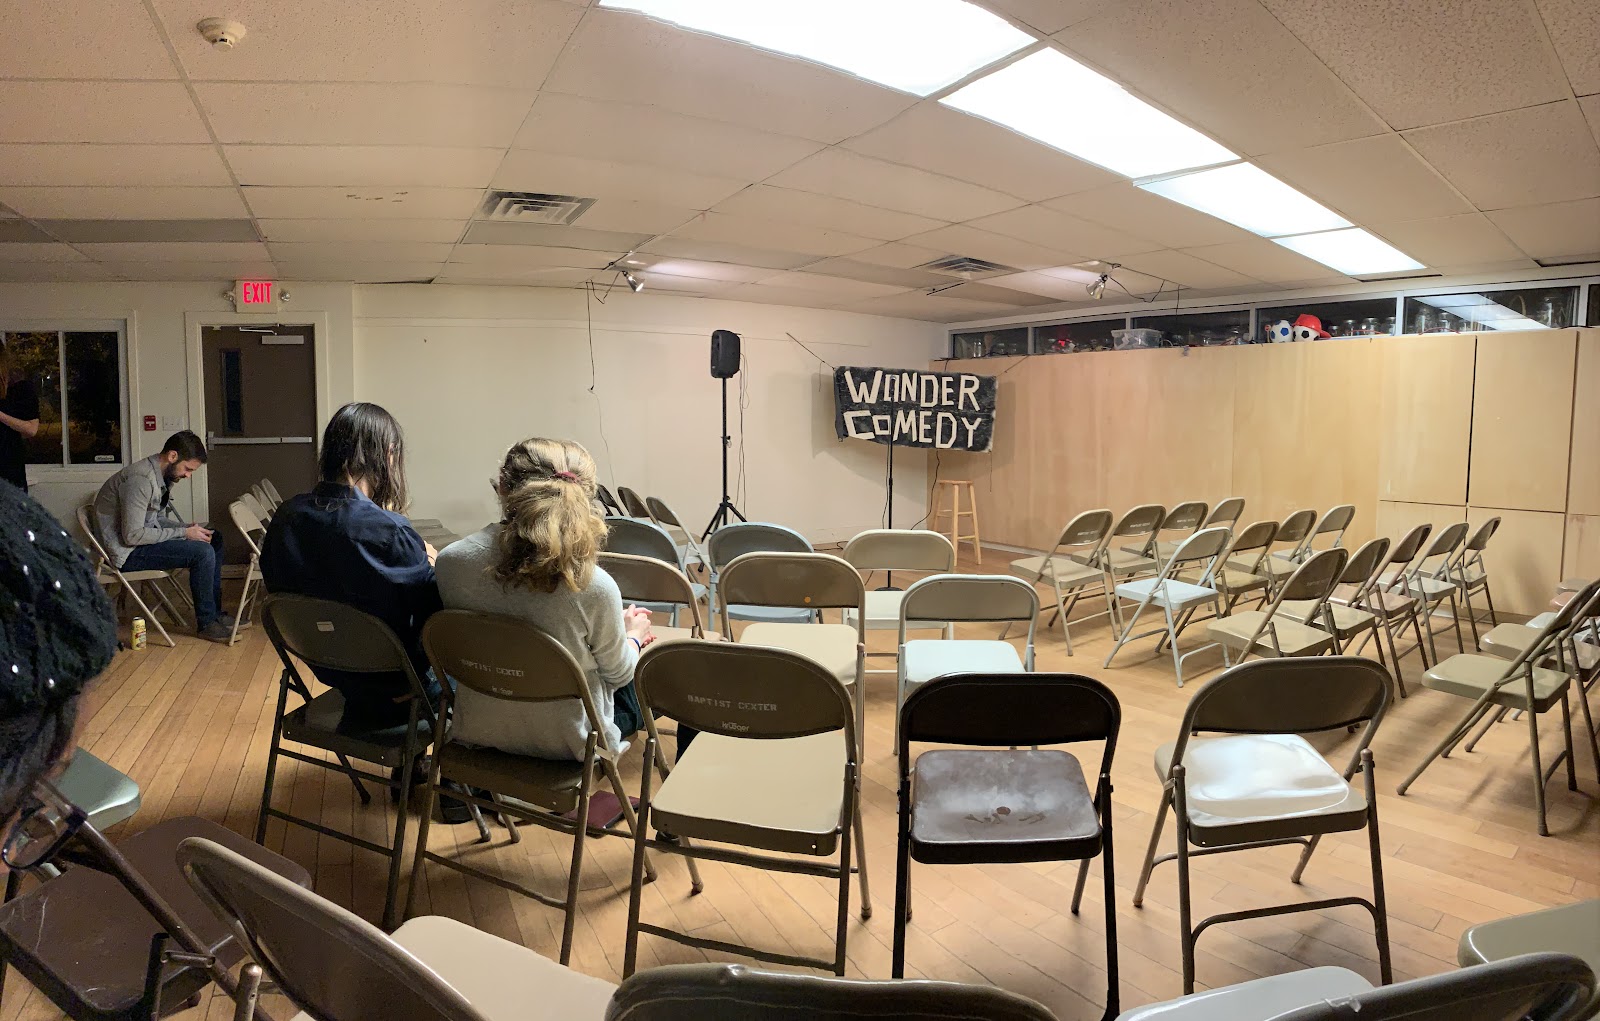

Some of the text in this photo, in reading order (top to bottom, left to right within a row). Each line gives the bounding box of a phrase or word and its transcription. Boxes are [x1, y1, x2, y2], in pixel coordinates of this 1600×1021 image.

[243, 282, 273, 304] EXIT
[843, 370, 981, 412] WONDER
[843, 409, 982, 449] COMEDY
[687, 694, 732, 709] BAPTIST
